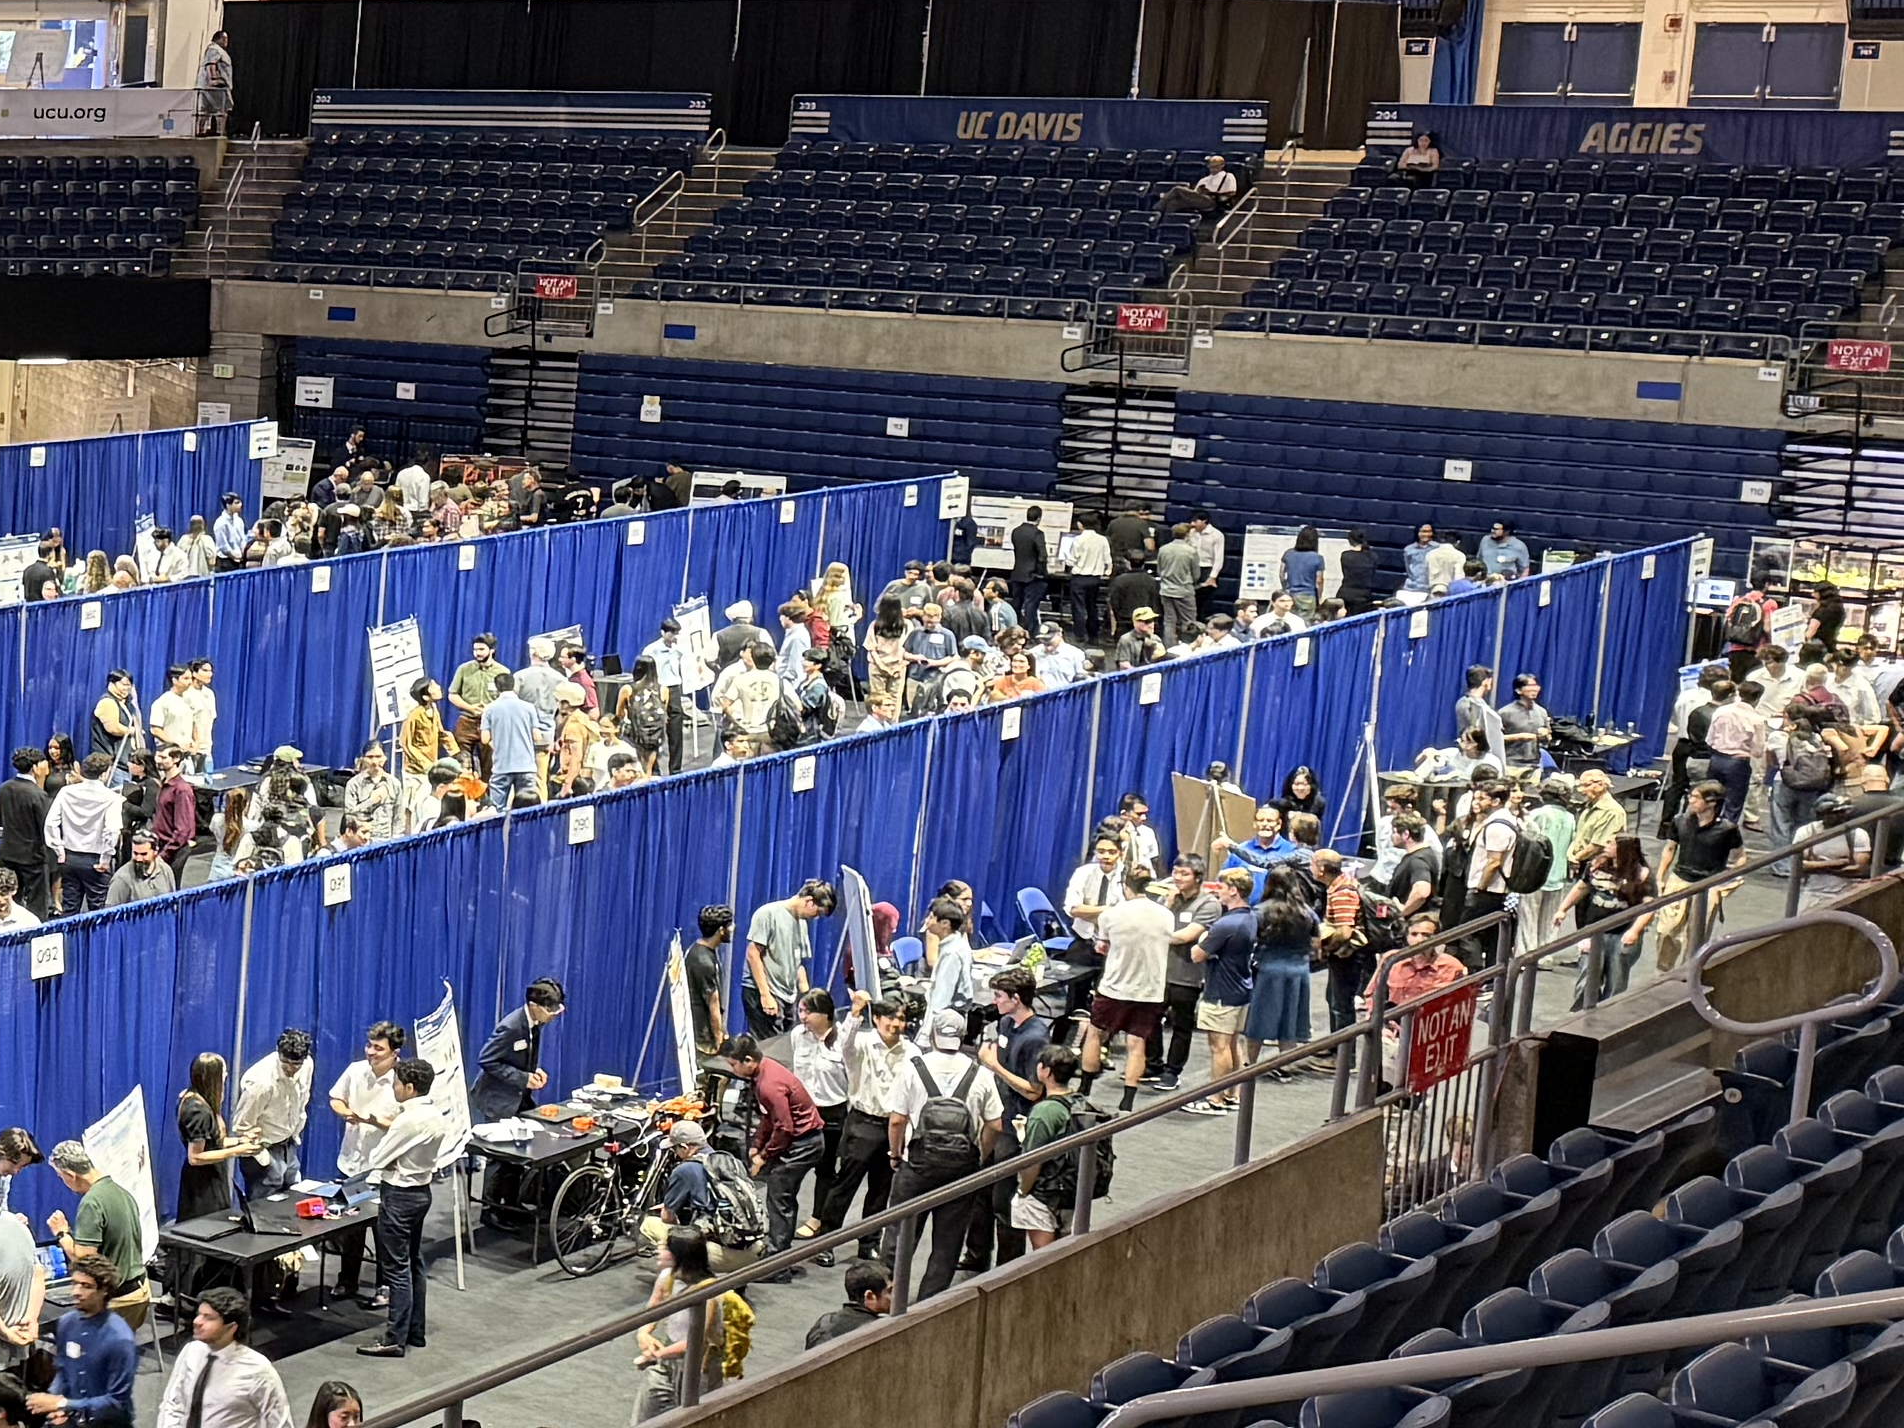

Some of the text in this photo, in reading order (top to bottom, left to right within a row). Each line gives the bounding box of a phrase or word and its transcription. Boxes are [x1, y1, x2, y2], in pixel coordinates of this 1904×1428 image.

[33, 106, 106, 122] ucu.org
[1242, 109, 1262, 118] 203
[1376, 111, 1398, 120] 204
[957, 112, 1084, 142] UC DAVIS
[1579, 122, 1706, 154] AGGIES
[1122, 309, 1162, 320] NOT AN
[1129, 316, 1153, 327] EXIT
[1833, 346, 1884, 358] NOT AN
[1840, 356, 1872, 366] EXIT
[37, 946, 58, 964] 092
[1417, 996, 1471, 1046] NOT AN
